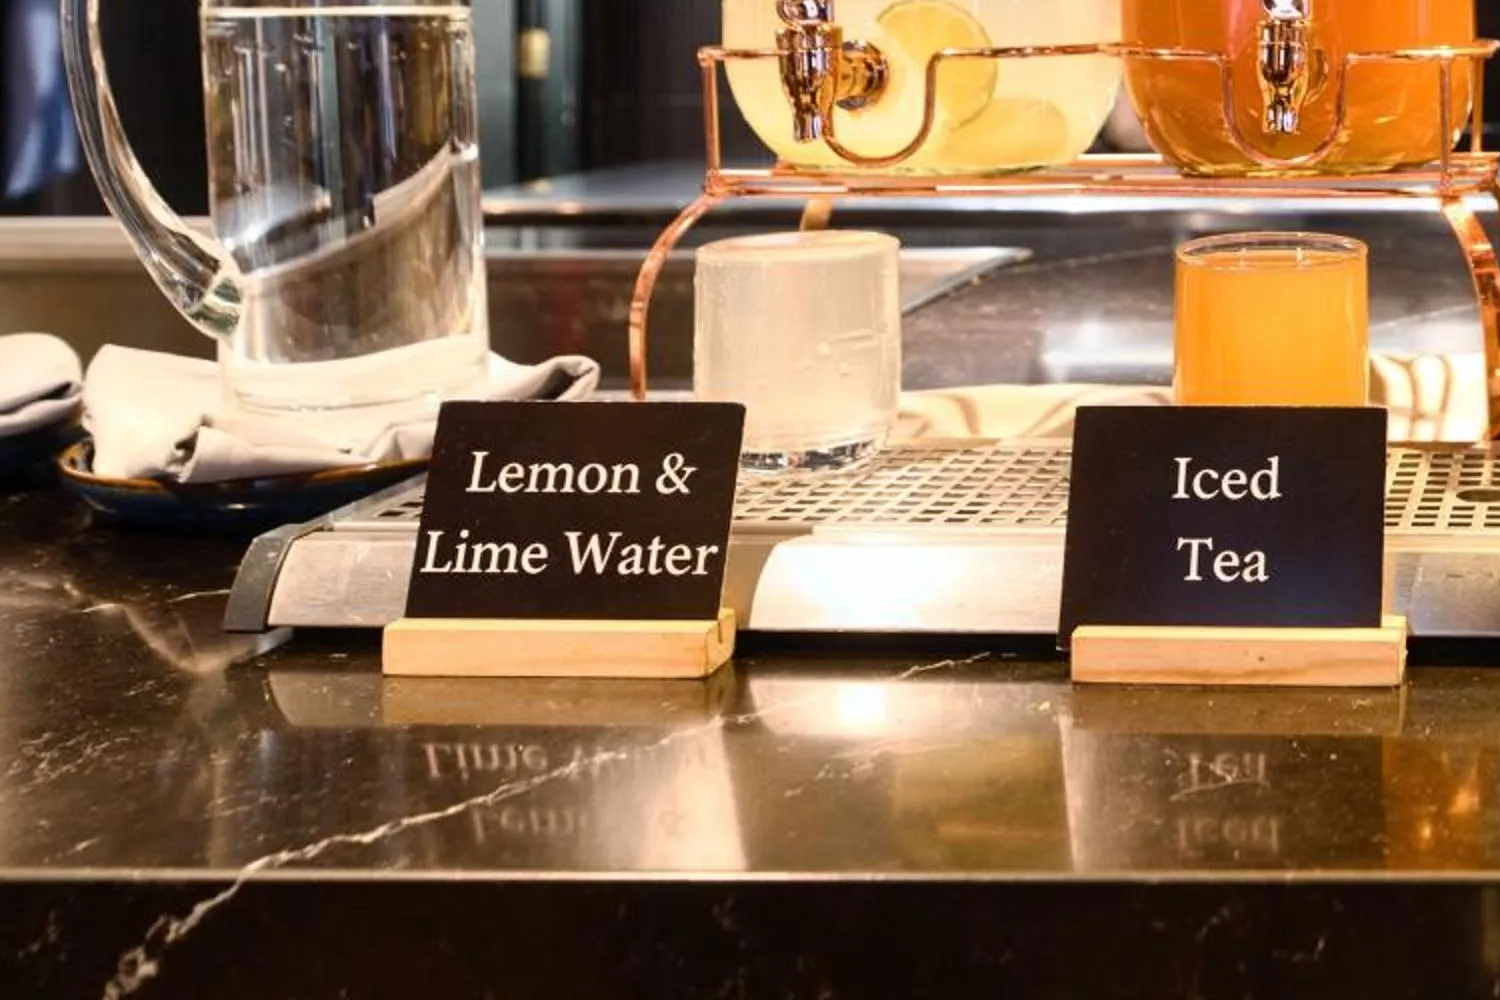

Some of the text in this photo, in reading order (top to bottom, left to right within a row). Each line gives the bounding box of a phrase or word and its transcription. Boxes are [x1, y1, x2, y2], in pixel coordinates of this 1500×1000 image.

[465, 450, 697, 495] Lemon &
[1172, 455, 1282, 501] Iced
[420, 529, 719, 576] Lime Water
[1176, 536, 1270, 583] Tea
